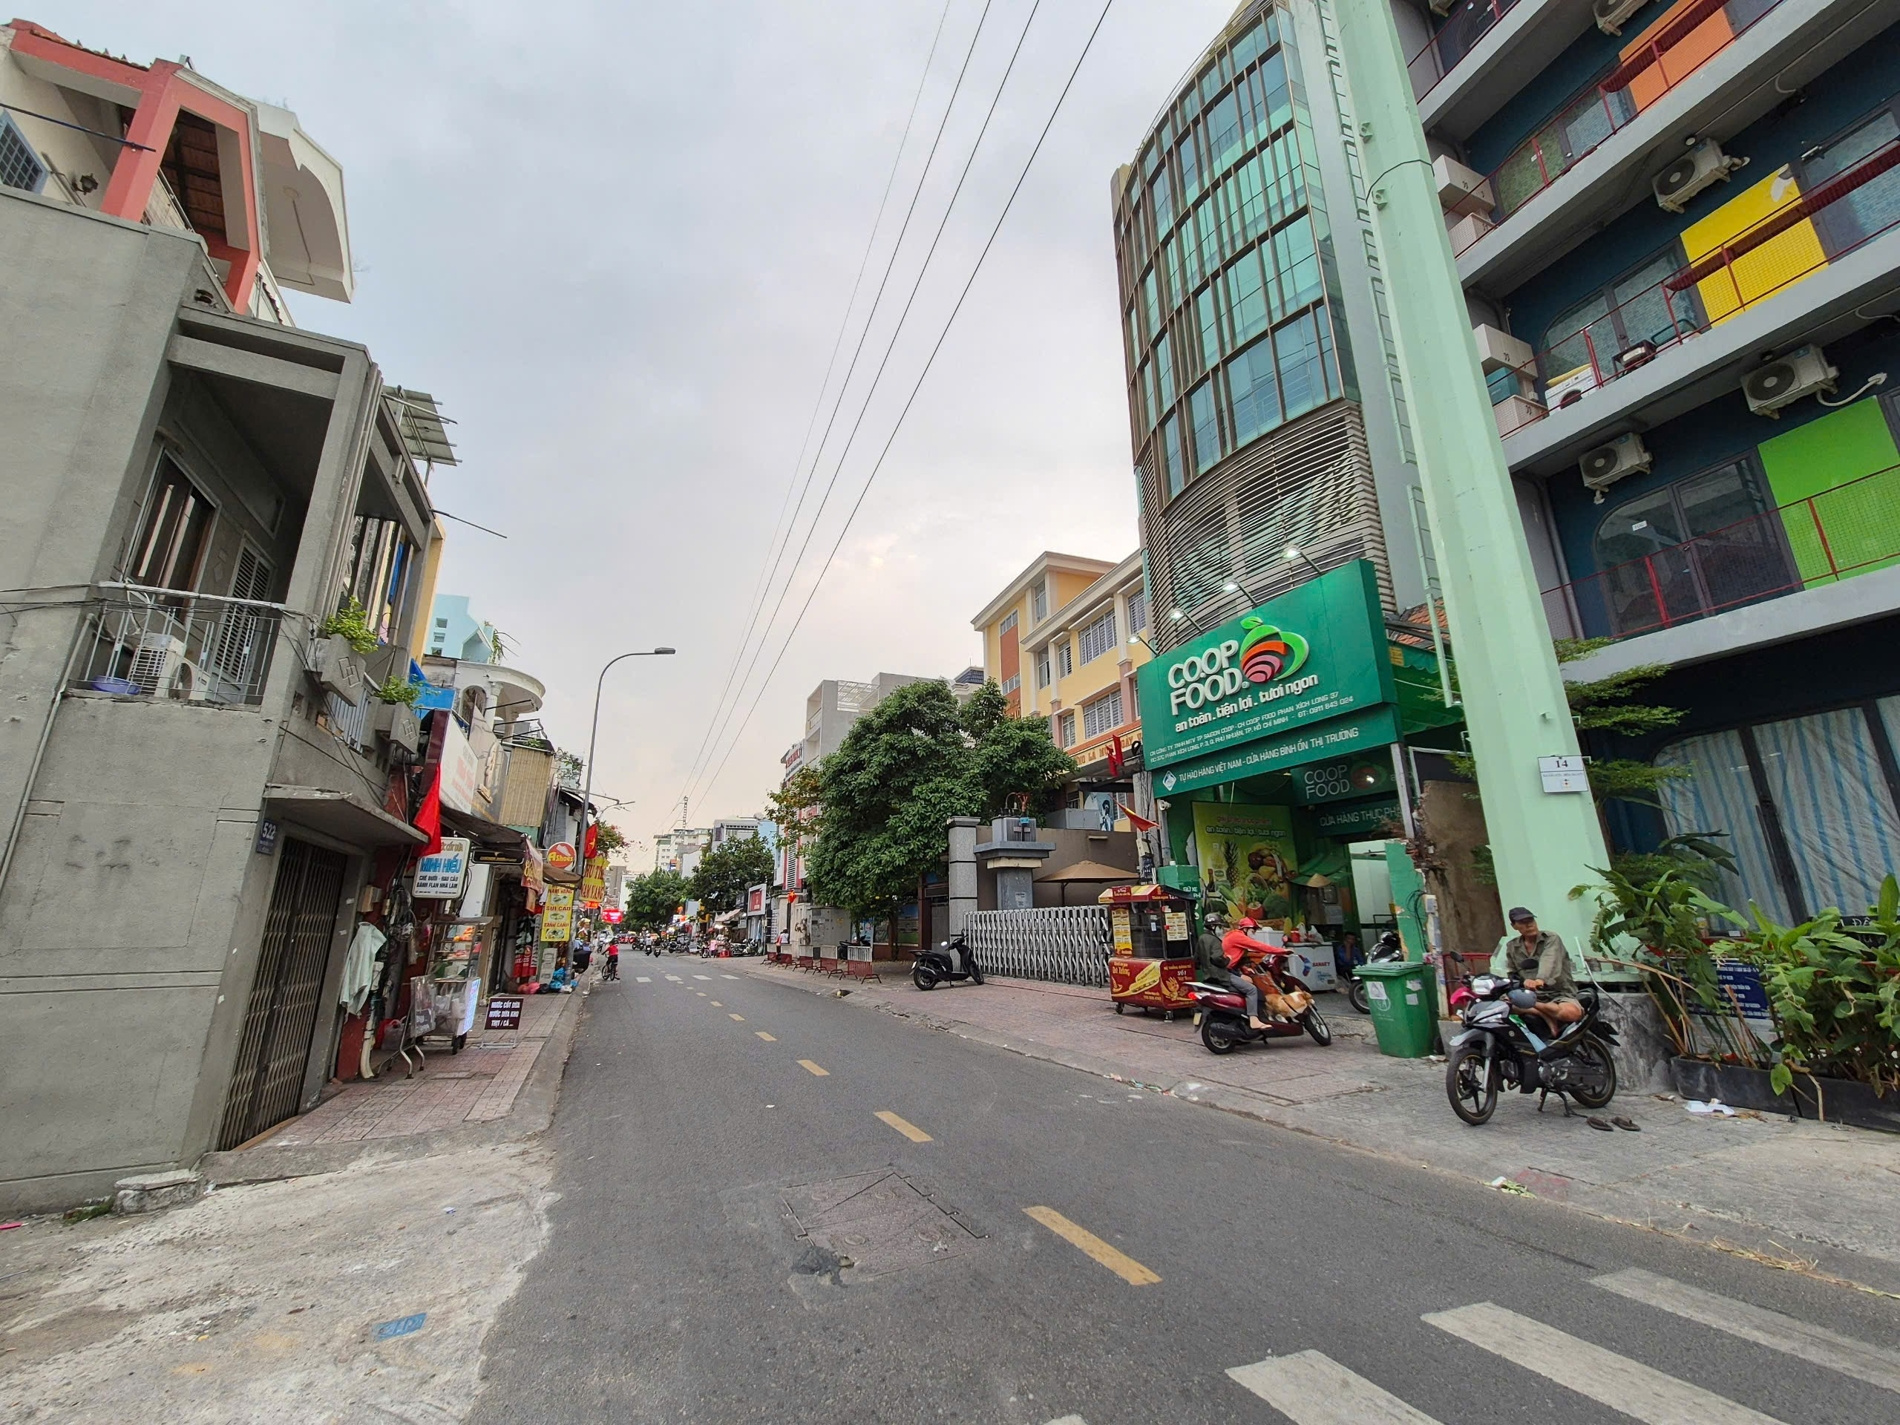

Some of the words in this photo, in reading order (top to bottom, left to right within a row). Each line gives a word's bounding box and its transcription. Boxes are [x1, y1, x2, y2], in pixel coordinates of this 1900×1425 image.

[1168, 640, 1239, 688] CO.OP
[1176, 721, 1188, 732] an
[1216, 703, 1238, 718] tiện
[1259, 684, 1285, 703] tươi
[1285, 674, 1319, 695] ngon
[1277, 706, 1294, 716] PHAN
[1311, 694, 1329, 705] LONG
[1187, 769, 1198, 780] HÀO
[1198, 766, 1215, 777] HÀNG
[1215, 761, 1227, 774] VIỆT
[1227, 759, 1243, 770] NAM
[1246, 752, 1260, 765] CỬA
[1260, 748, 1280, 761] HÀNG
[1280, 744, 1297, 756] BÌNH
[1310, 737, 1324, 748] THỊ
[1325, 727, 1359, 744] TRƯỜNG
[1556, 760, 1568, 768] 14
[1305, 779, 1350, 799] FOOD
[262, 822, 277, 840] 522
